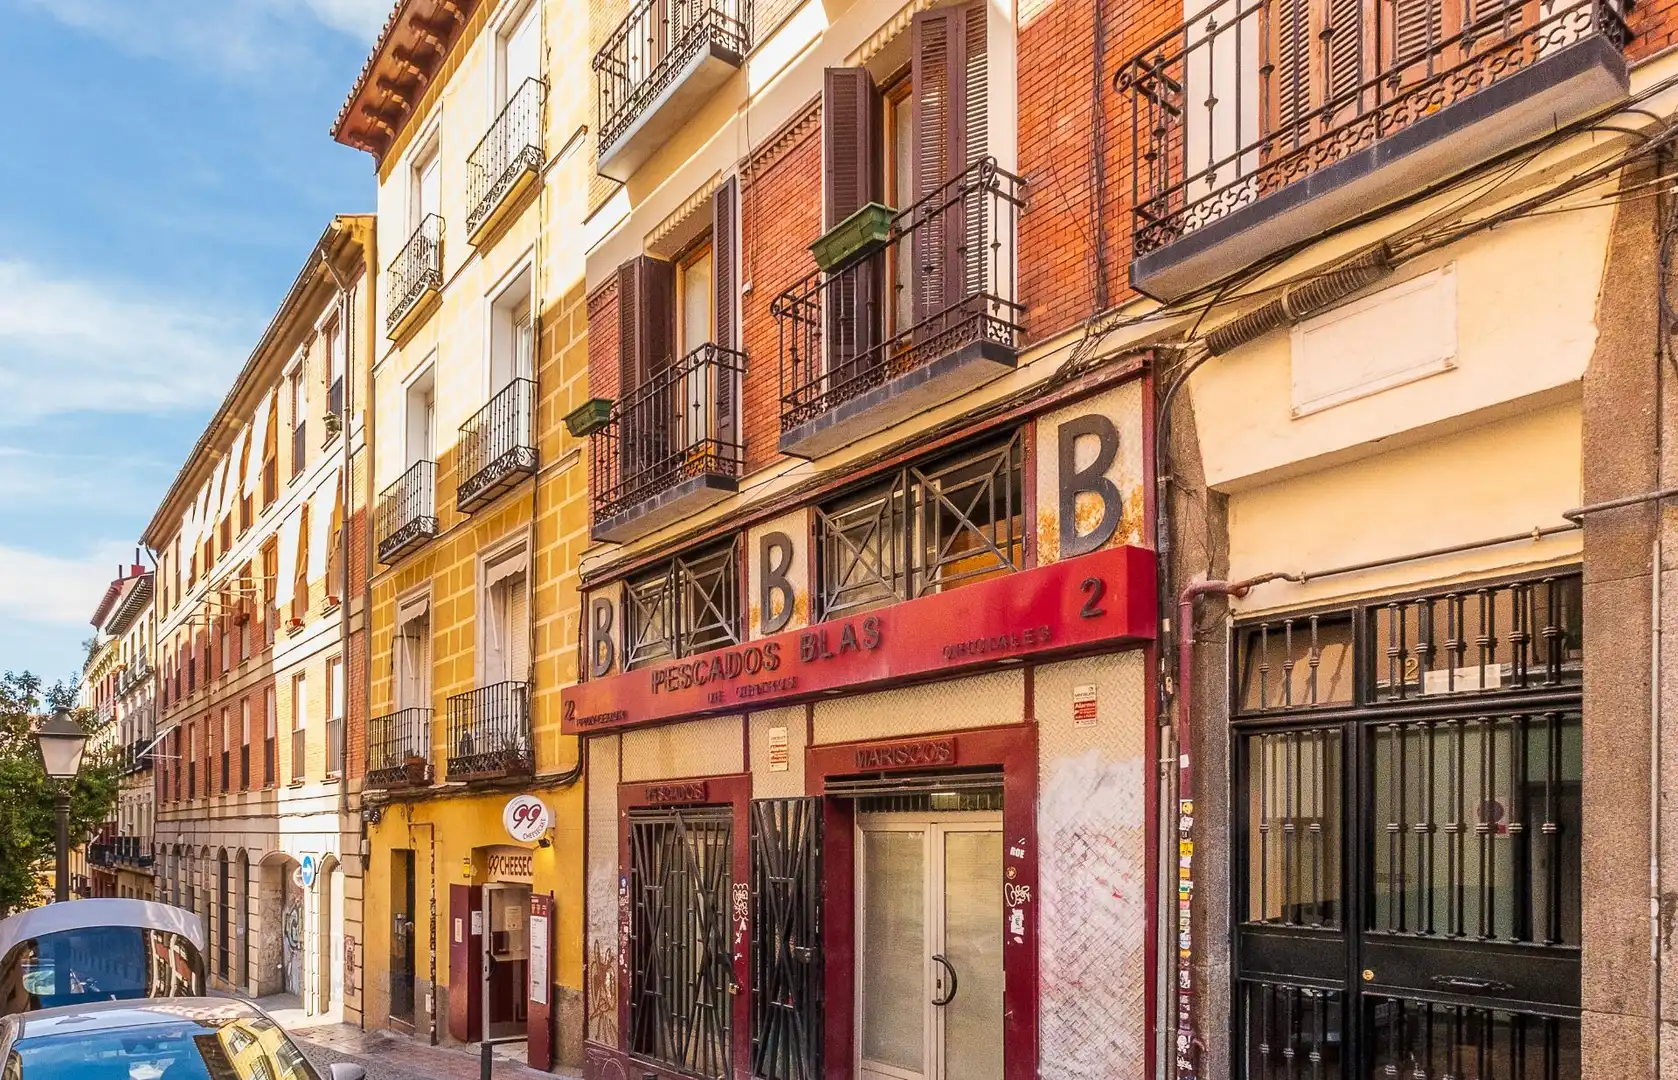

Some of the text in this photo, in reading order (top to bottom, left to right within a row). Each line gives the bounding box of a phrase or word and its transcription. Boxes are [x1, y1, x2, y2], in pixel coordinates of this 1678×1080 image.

[591, 413, 1123, 677] B B B
[1080, 577, 1105, 618] 2
[651, 616, 882, 694] PESCADOS BLAS
[1405, 658, 1419, 681] 2
[854, 740, 950, 768] MARISCOS
[513, 804, 542, 829] 99
[488, 855, 499, 875] 99
